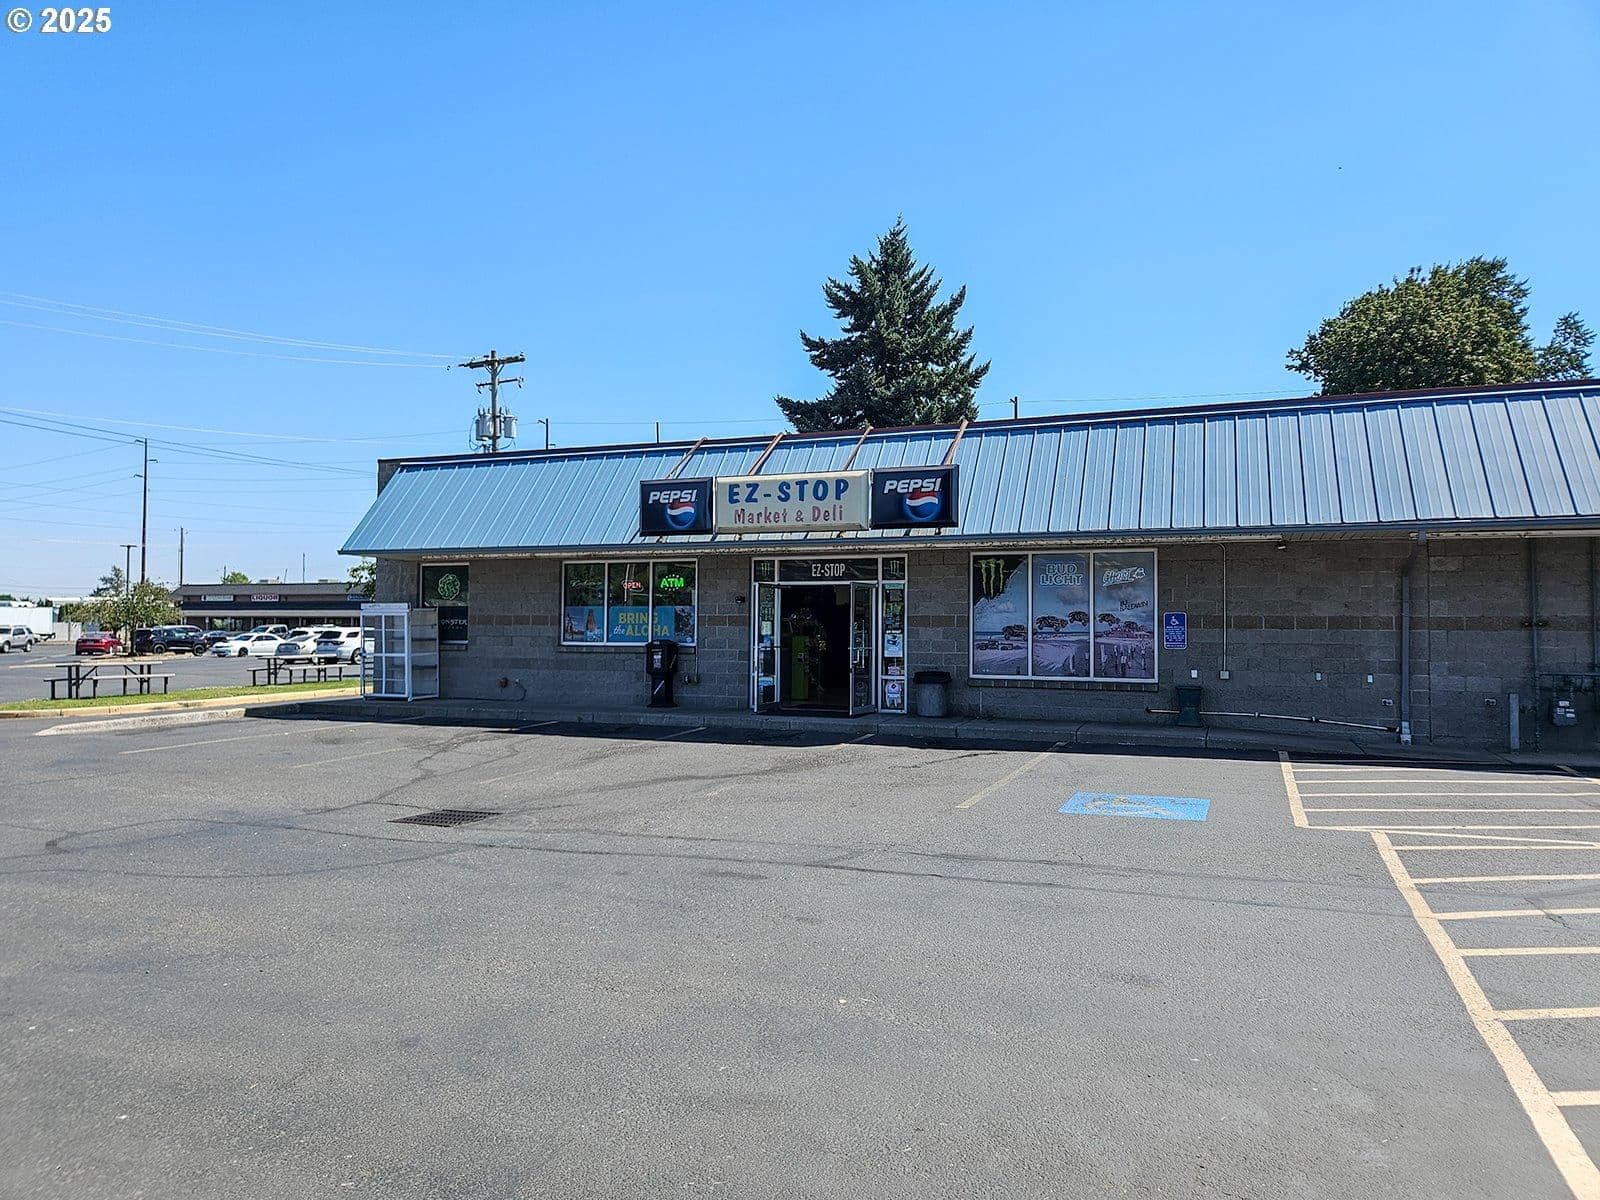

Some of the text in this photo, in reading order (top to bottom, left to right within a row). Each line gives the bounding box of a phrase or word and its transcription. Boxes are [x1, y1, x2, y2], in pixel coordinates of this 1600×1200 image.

[728, 478, 850, 505] EZ-STOP
[884, 477, 942, 494] PEPSI
[648, 489, 698, 504] PEPSI
[733, 504, 844, 524] Market & Deli
[811, 563, 846, 577] EZ-STOP
[1045, 563, 1078, 575] BUD
[660, 577, 684, 589] ATM
[1040, 574, 1083, 586] LIGHT
[613, 624, 626, 635] the
